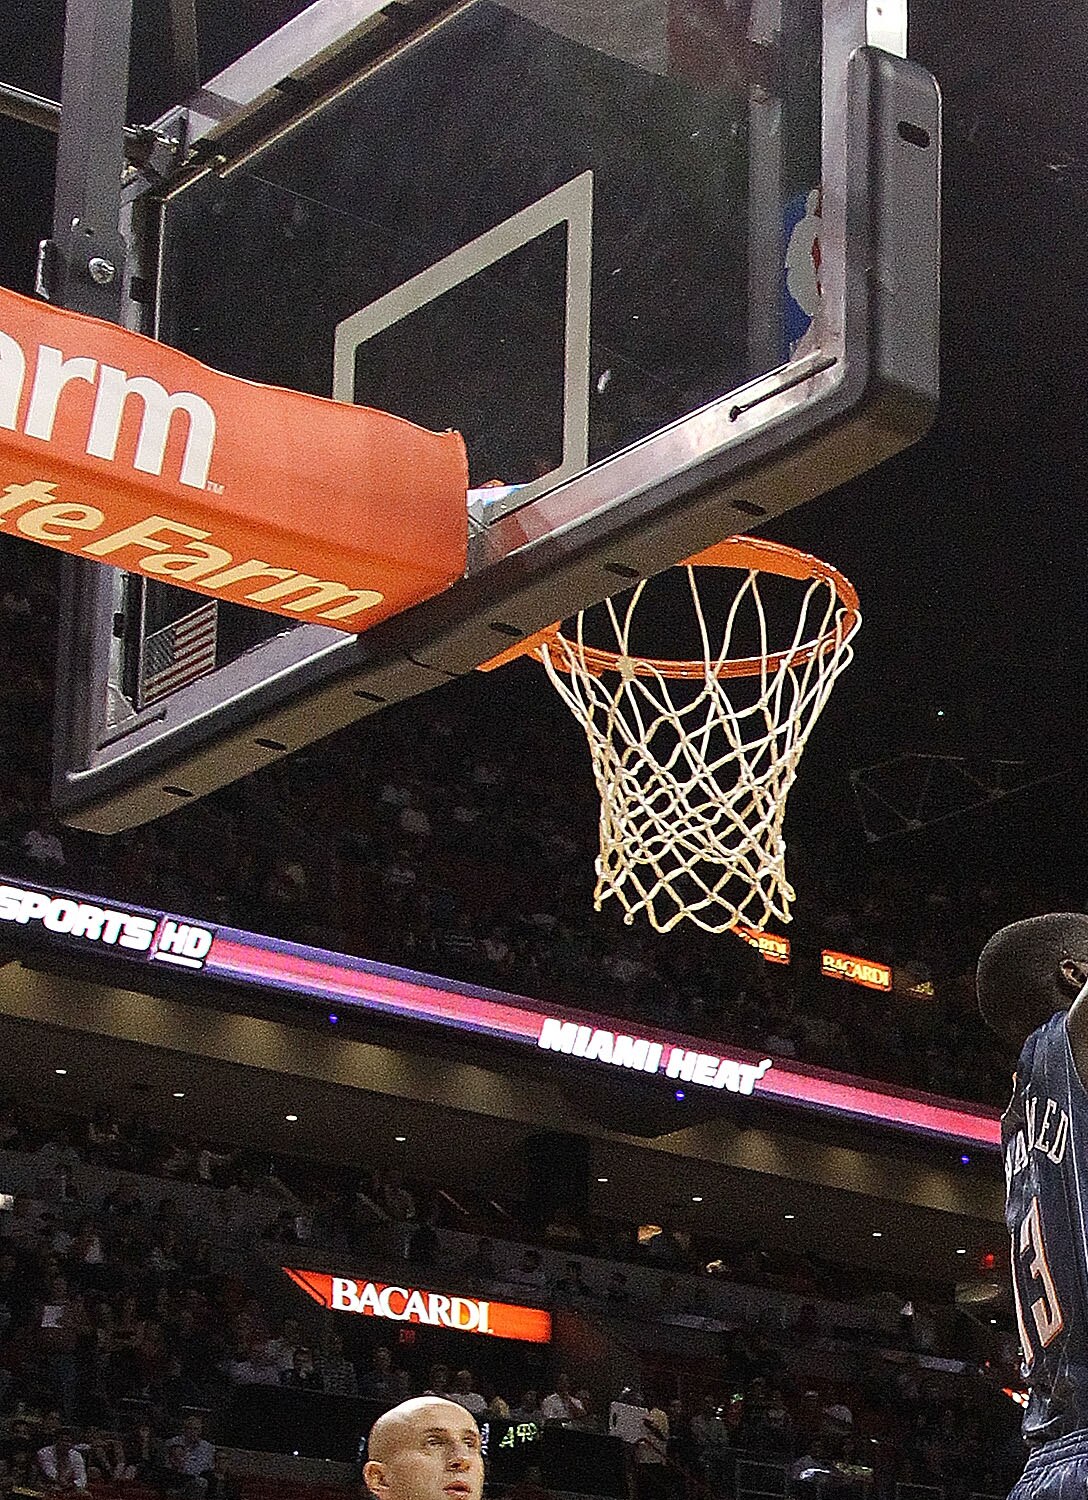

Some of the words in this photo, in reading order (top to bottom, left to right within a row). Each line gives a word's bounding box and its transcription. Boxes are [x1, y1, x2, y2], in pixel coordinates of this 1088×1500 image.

[82, 515, 385, 620] Farm
[0, 885, 157, 951] SPORTS
[158, 921, 214, 959] HD
[537, 1018, 664, 1074] MIAMI
[665, 1048, 772, 1095] HEAT
